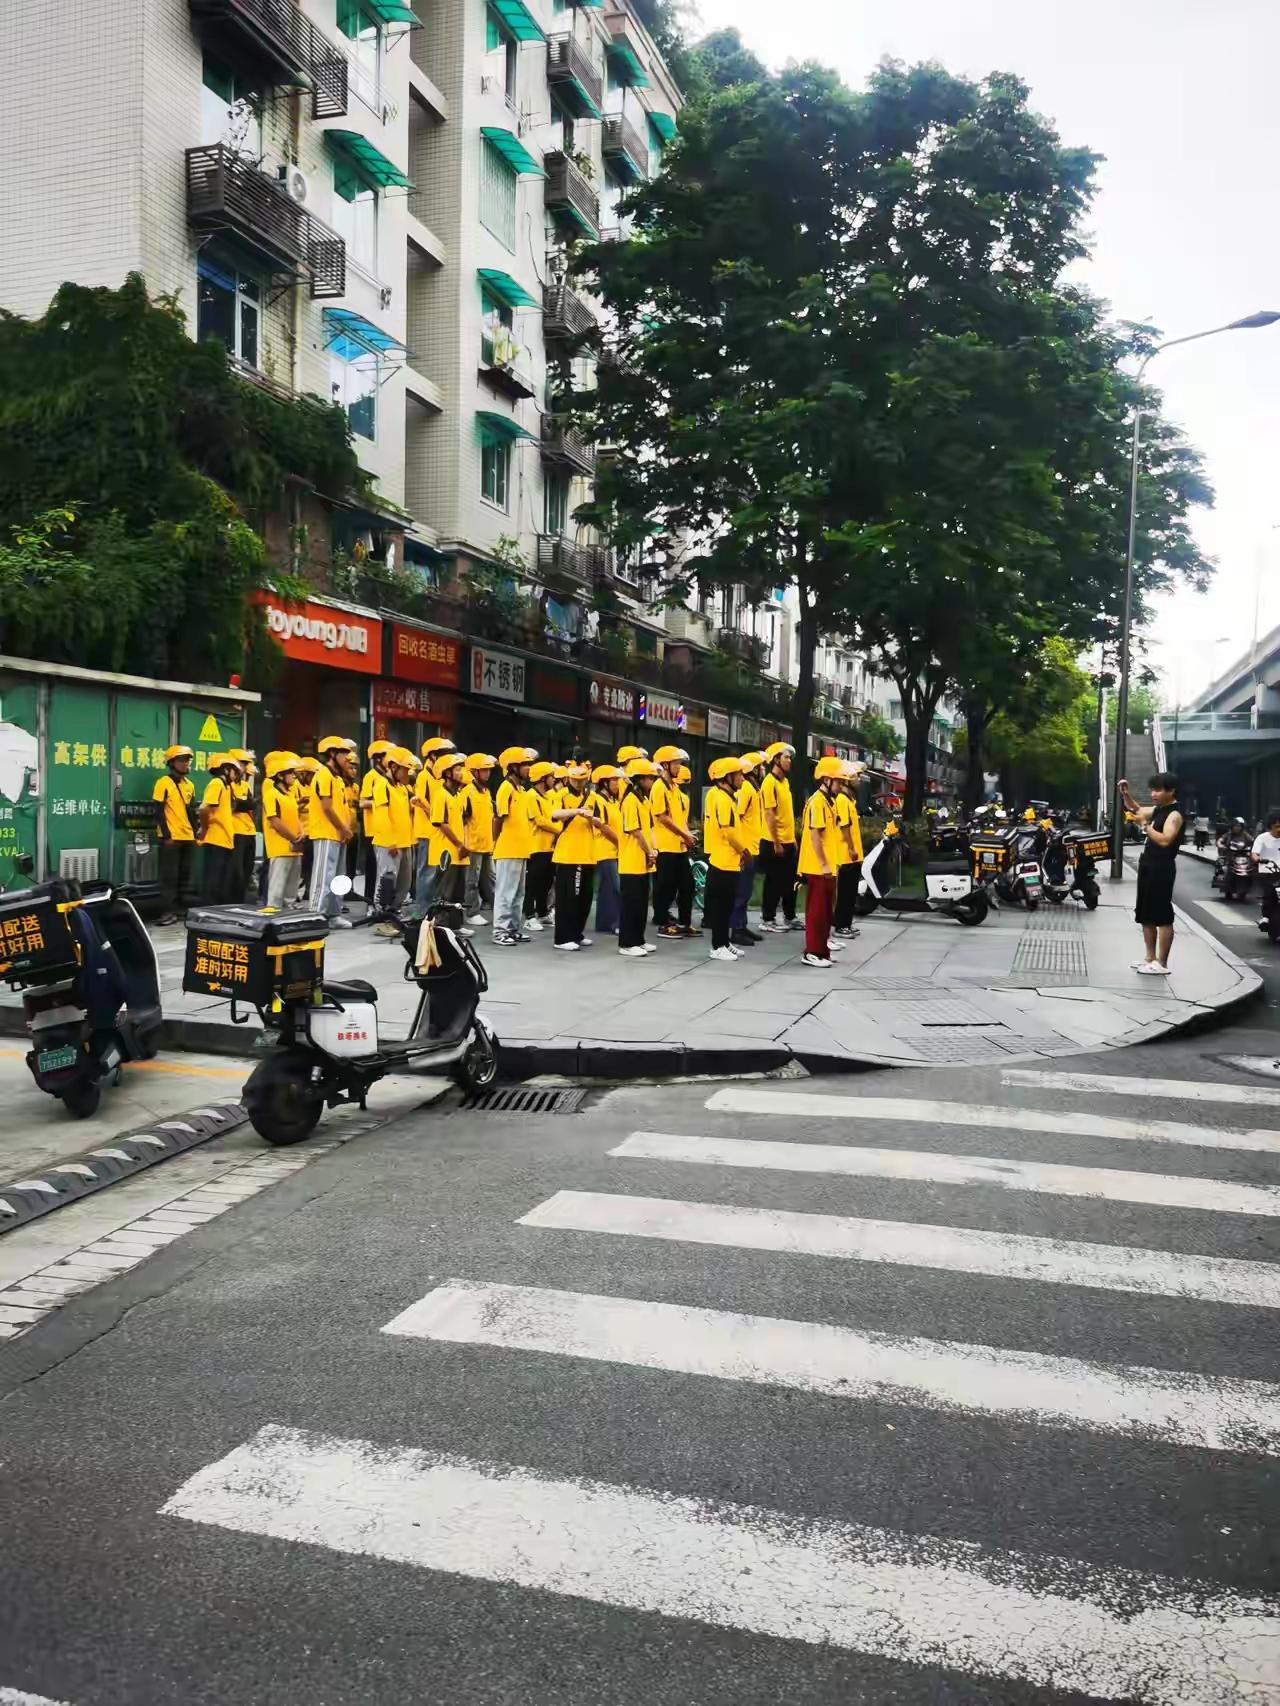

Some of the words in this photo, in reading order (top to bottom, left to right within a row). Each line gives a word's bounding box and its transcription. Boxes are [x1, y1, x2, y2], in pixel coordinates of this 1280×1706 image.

[483, 656, 524, 693] 不锈钢
[0, 827, 16, 838] 33
[0, 913, 41, 938] 配送
[196, 937, 249, 964] 美团配送
[194, 956, 249, 984] 准时好用
